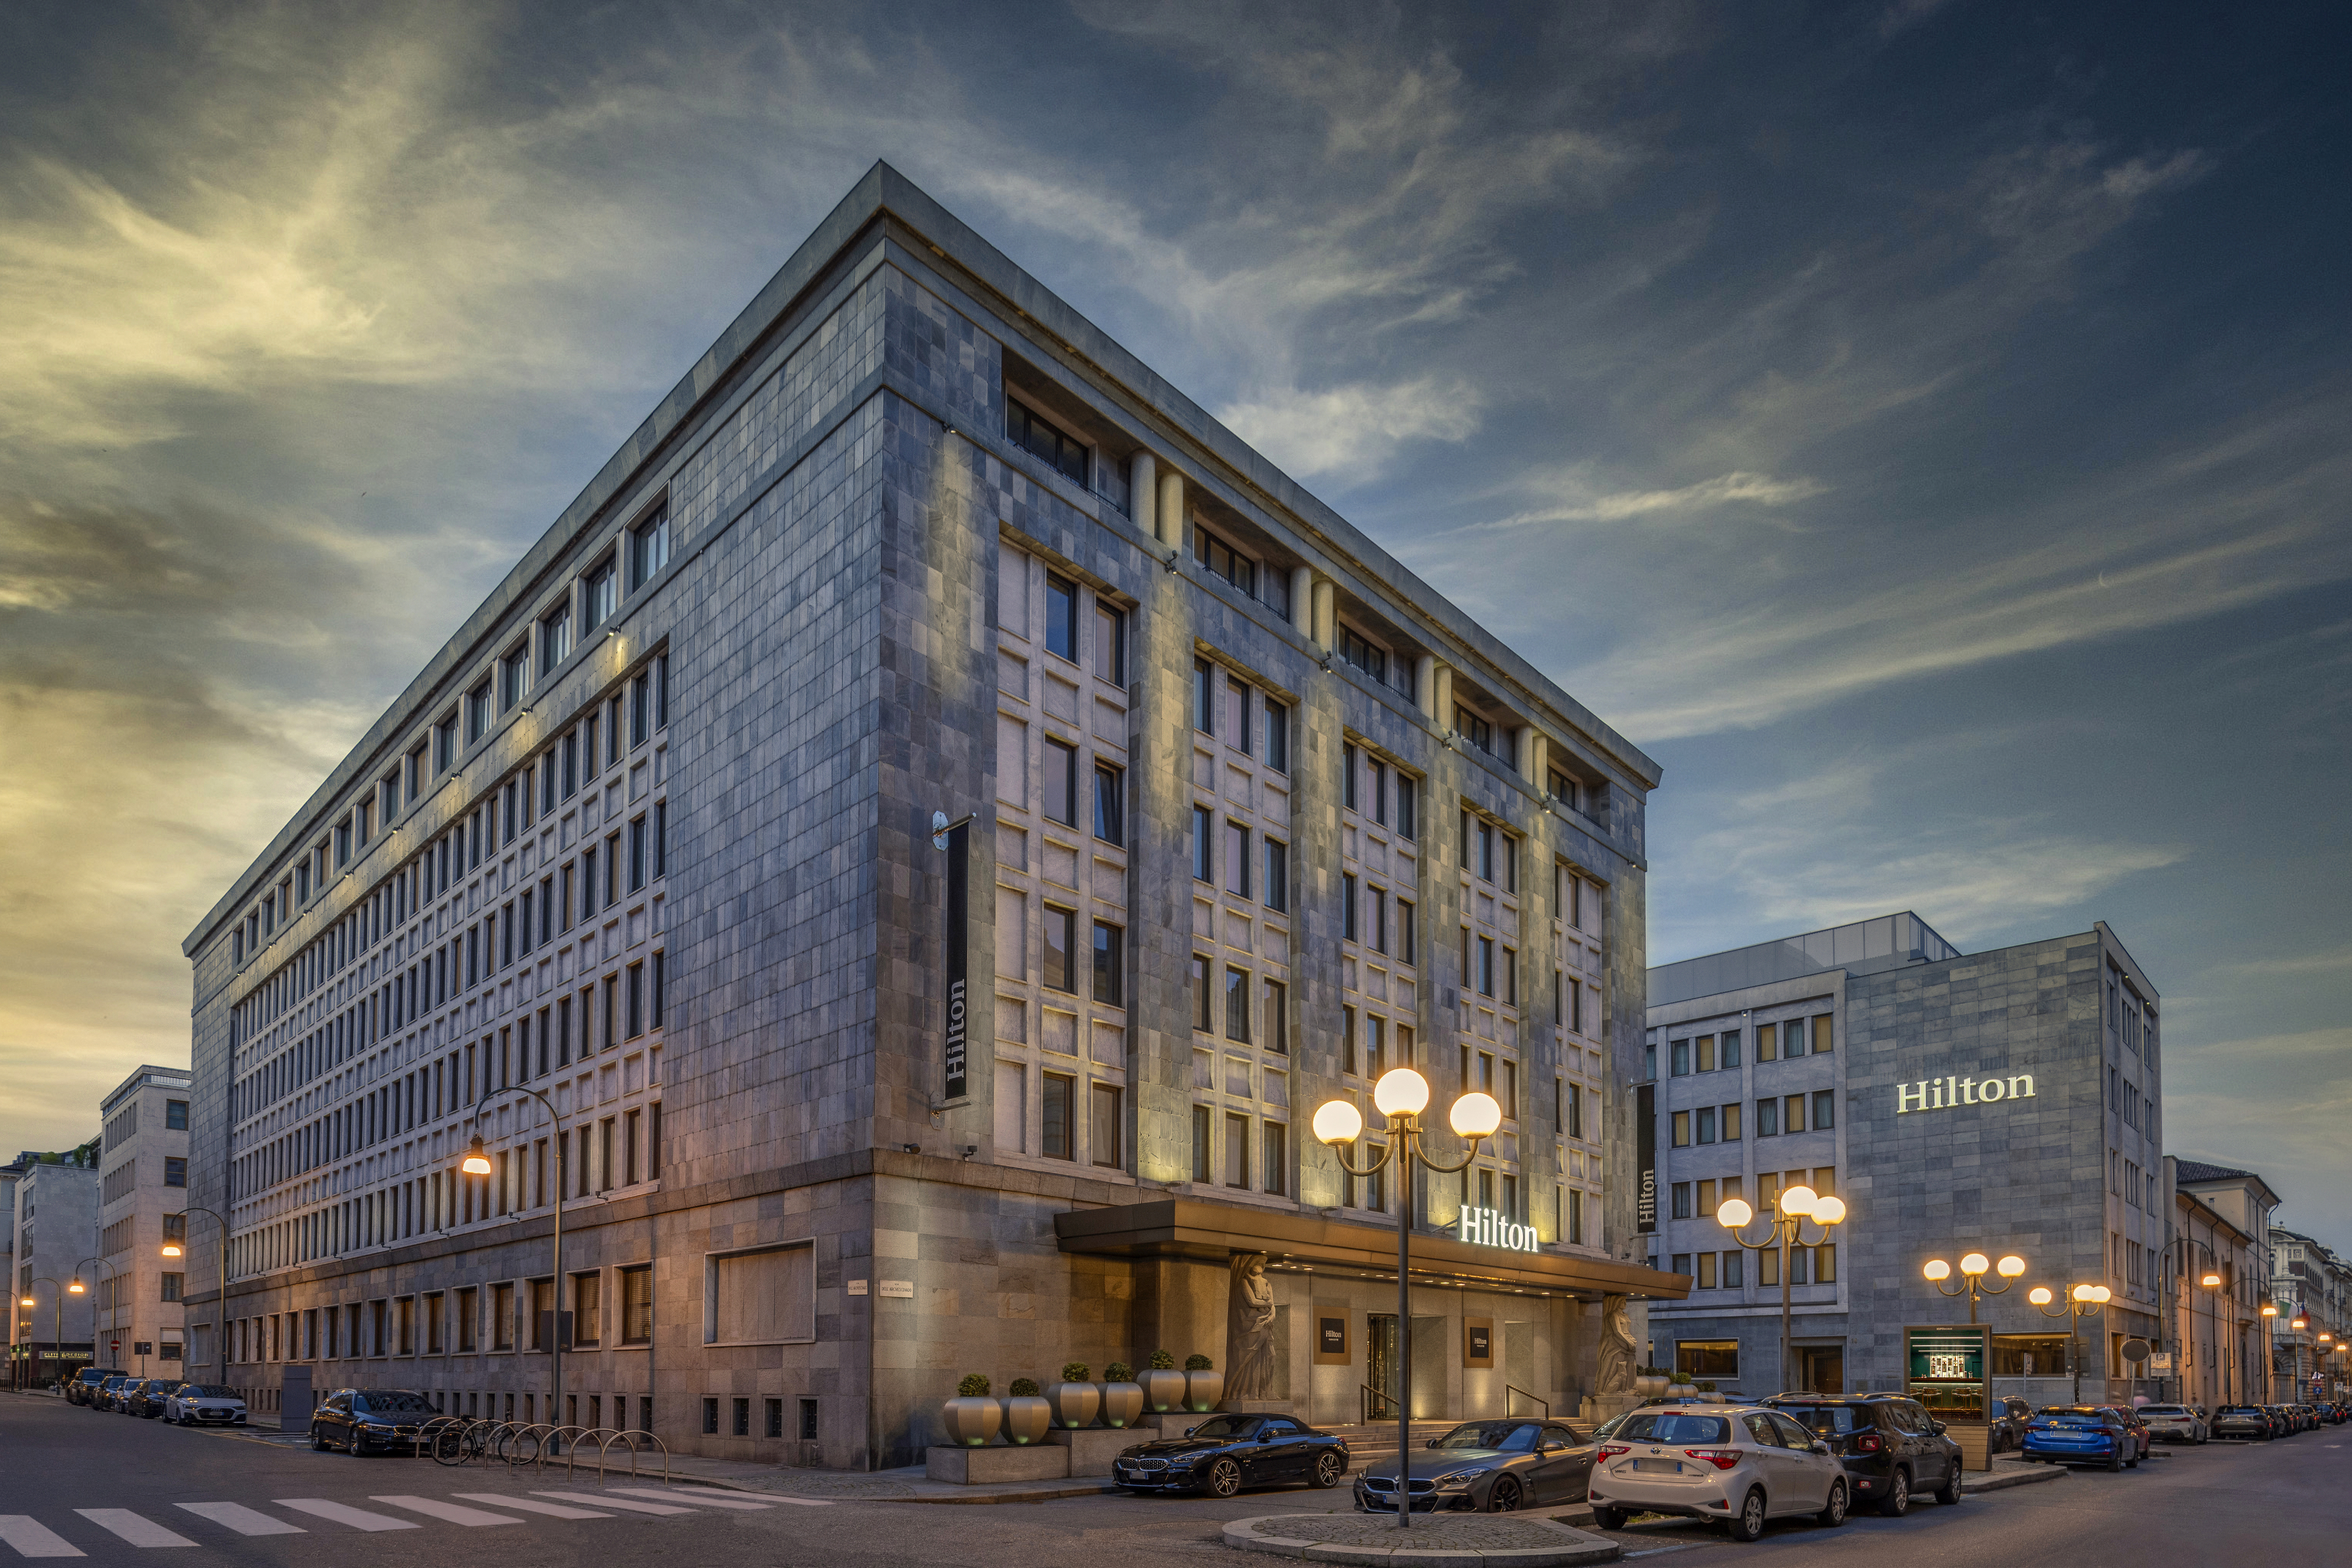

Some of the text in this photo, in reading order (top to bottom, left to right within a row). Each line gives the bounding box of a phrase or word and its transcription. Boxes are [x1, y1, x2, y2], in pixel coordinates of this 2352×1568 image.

[947, 979, 964, 1082] Hilton
[1896, 1074, 2036, 1113] Hilton
[1639, 1169, 1654, 1223] Hilton
[1461, 1205, 1538, 1252] Hilton
